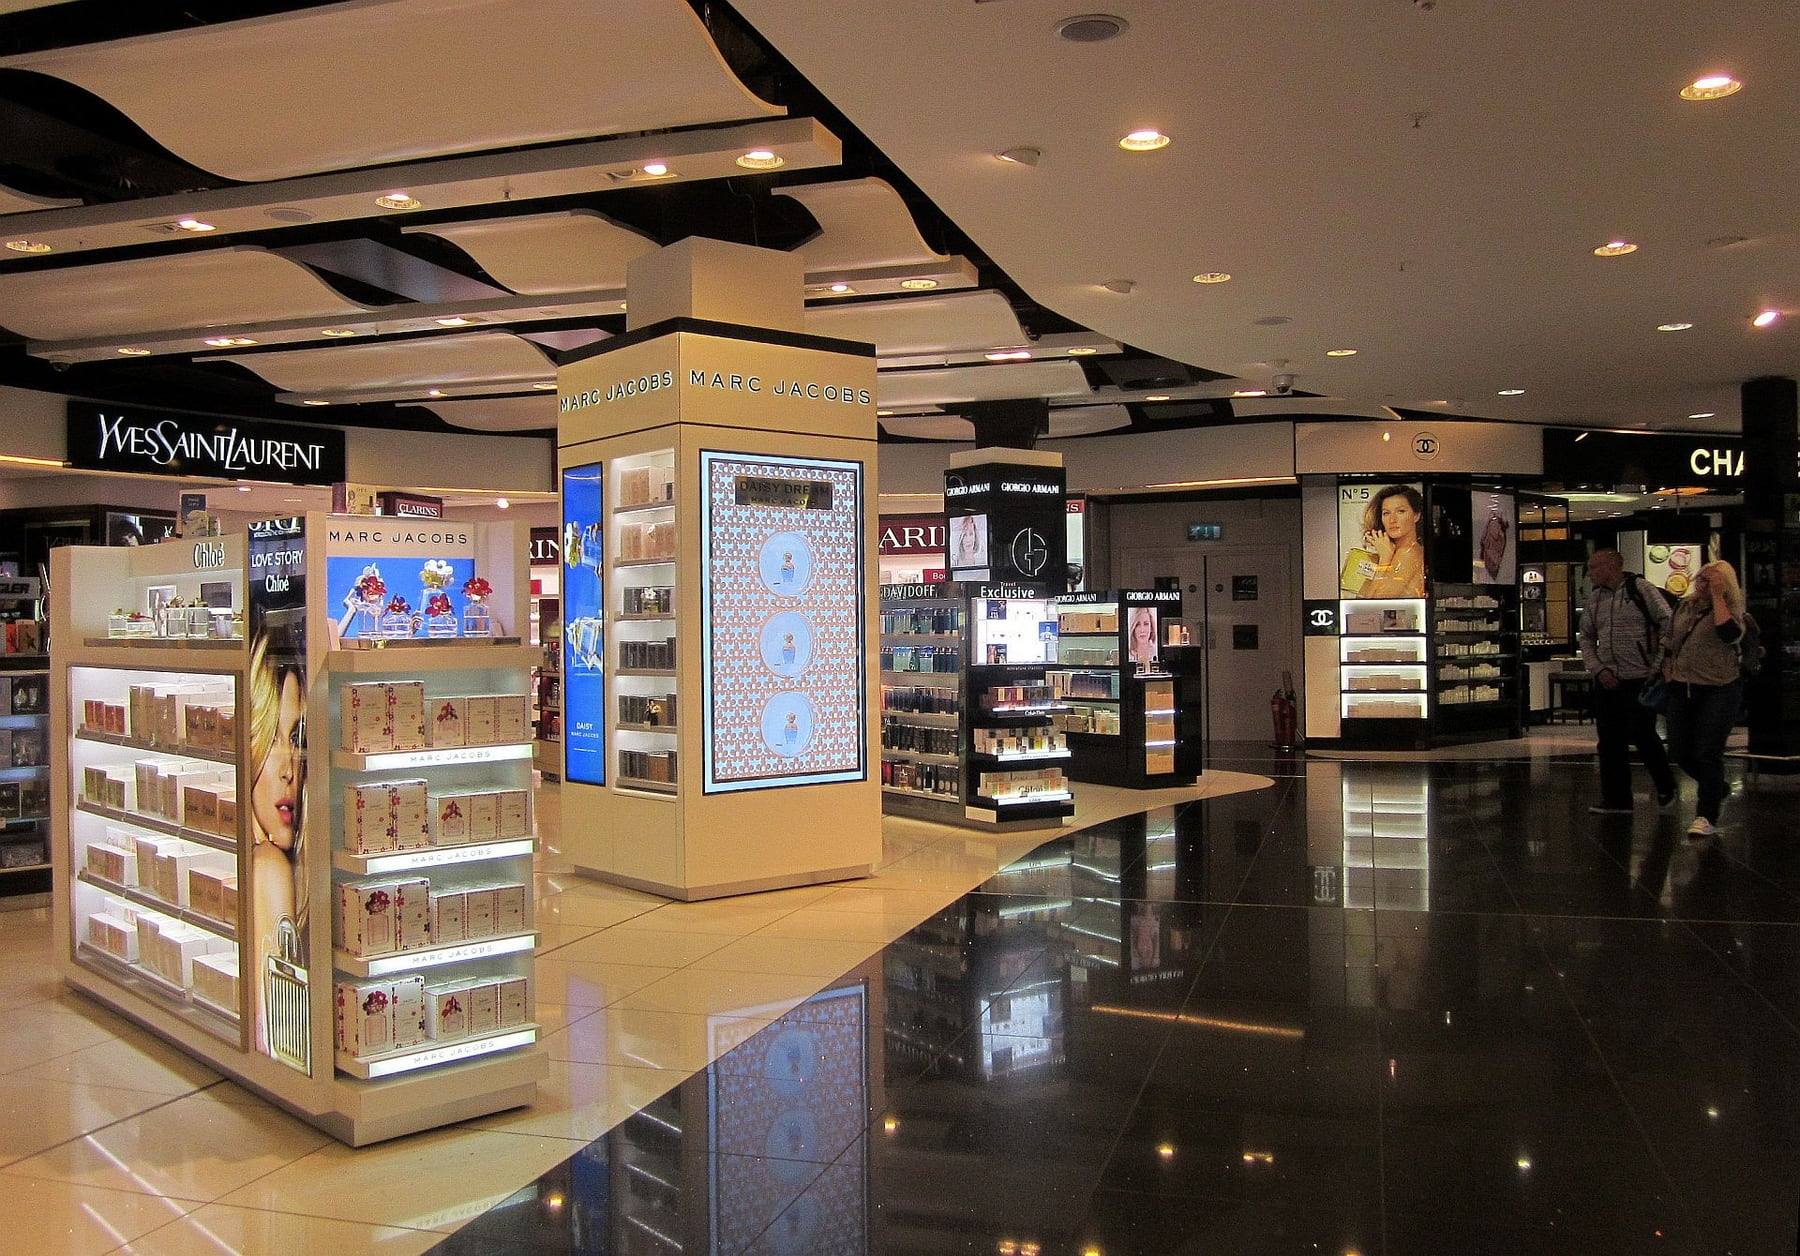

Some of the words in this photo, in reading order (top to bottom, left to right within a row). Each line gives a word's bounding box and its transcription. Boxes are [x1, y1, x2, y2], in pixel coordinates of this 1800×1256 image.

[560, 389, 601, 413] MARC
[606, 371, 673, 401] JACOBS
[689, 370, 761, 392] MARC
[773, 380, 871, 405] JACOBS
[947, 486, 968, 497] GIORGIO
[968, 482, 990, 494] ARMANI
[1001, 482, 1031, 493] GIORGIO
[1032, 484, 1060, 494] ARMANI
[1360, 487, 1369, 499] 5
[399, 503, 438, 516] CLARINS
[329, 531, 383, 543] MARC
[391, 533, 468, 544] JACOBS
[879, 526, 945, 548] ARI
[194, 542, 225, 568] Chloé
[530, 539, 560, 558] IN
[251, 553, 274, 568] LOVE
[274, 550, 304, 567] STORY
[265, 574, 290, 592] Chloé
[932, 572, 945, 580] Bo
[883, 585, 936, 599] DAVIDOFF
[980, 585, 1035, 599] Exclusive
[1076, 593, 1097, 602] ARMANI
[1126, 591, 1154, 601] GIORGIO
[1154, 591, 1180, 601] ARMANI
[410, 754, 441, 763] MARC
[446, 750, 491, 761] JACOBS
[411, 854, 442, 864] MARC
[447, 847, 492, 859] JACOBS
[412, 953, 443, 964] MARC
[448, 944, 493, 957] JACOBS
[413, 1053, 444, 1064] MARC
[450, 1040, 495, 1055] JACOBS
